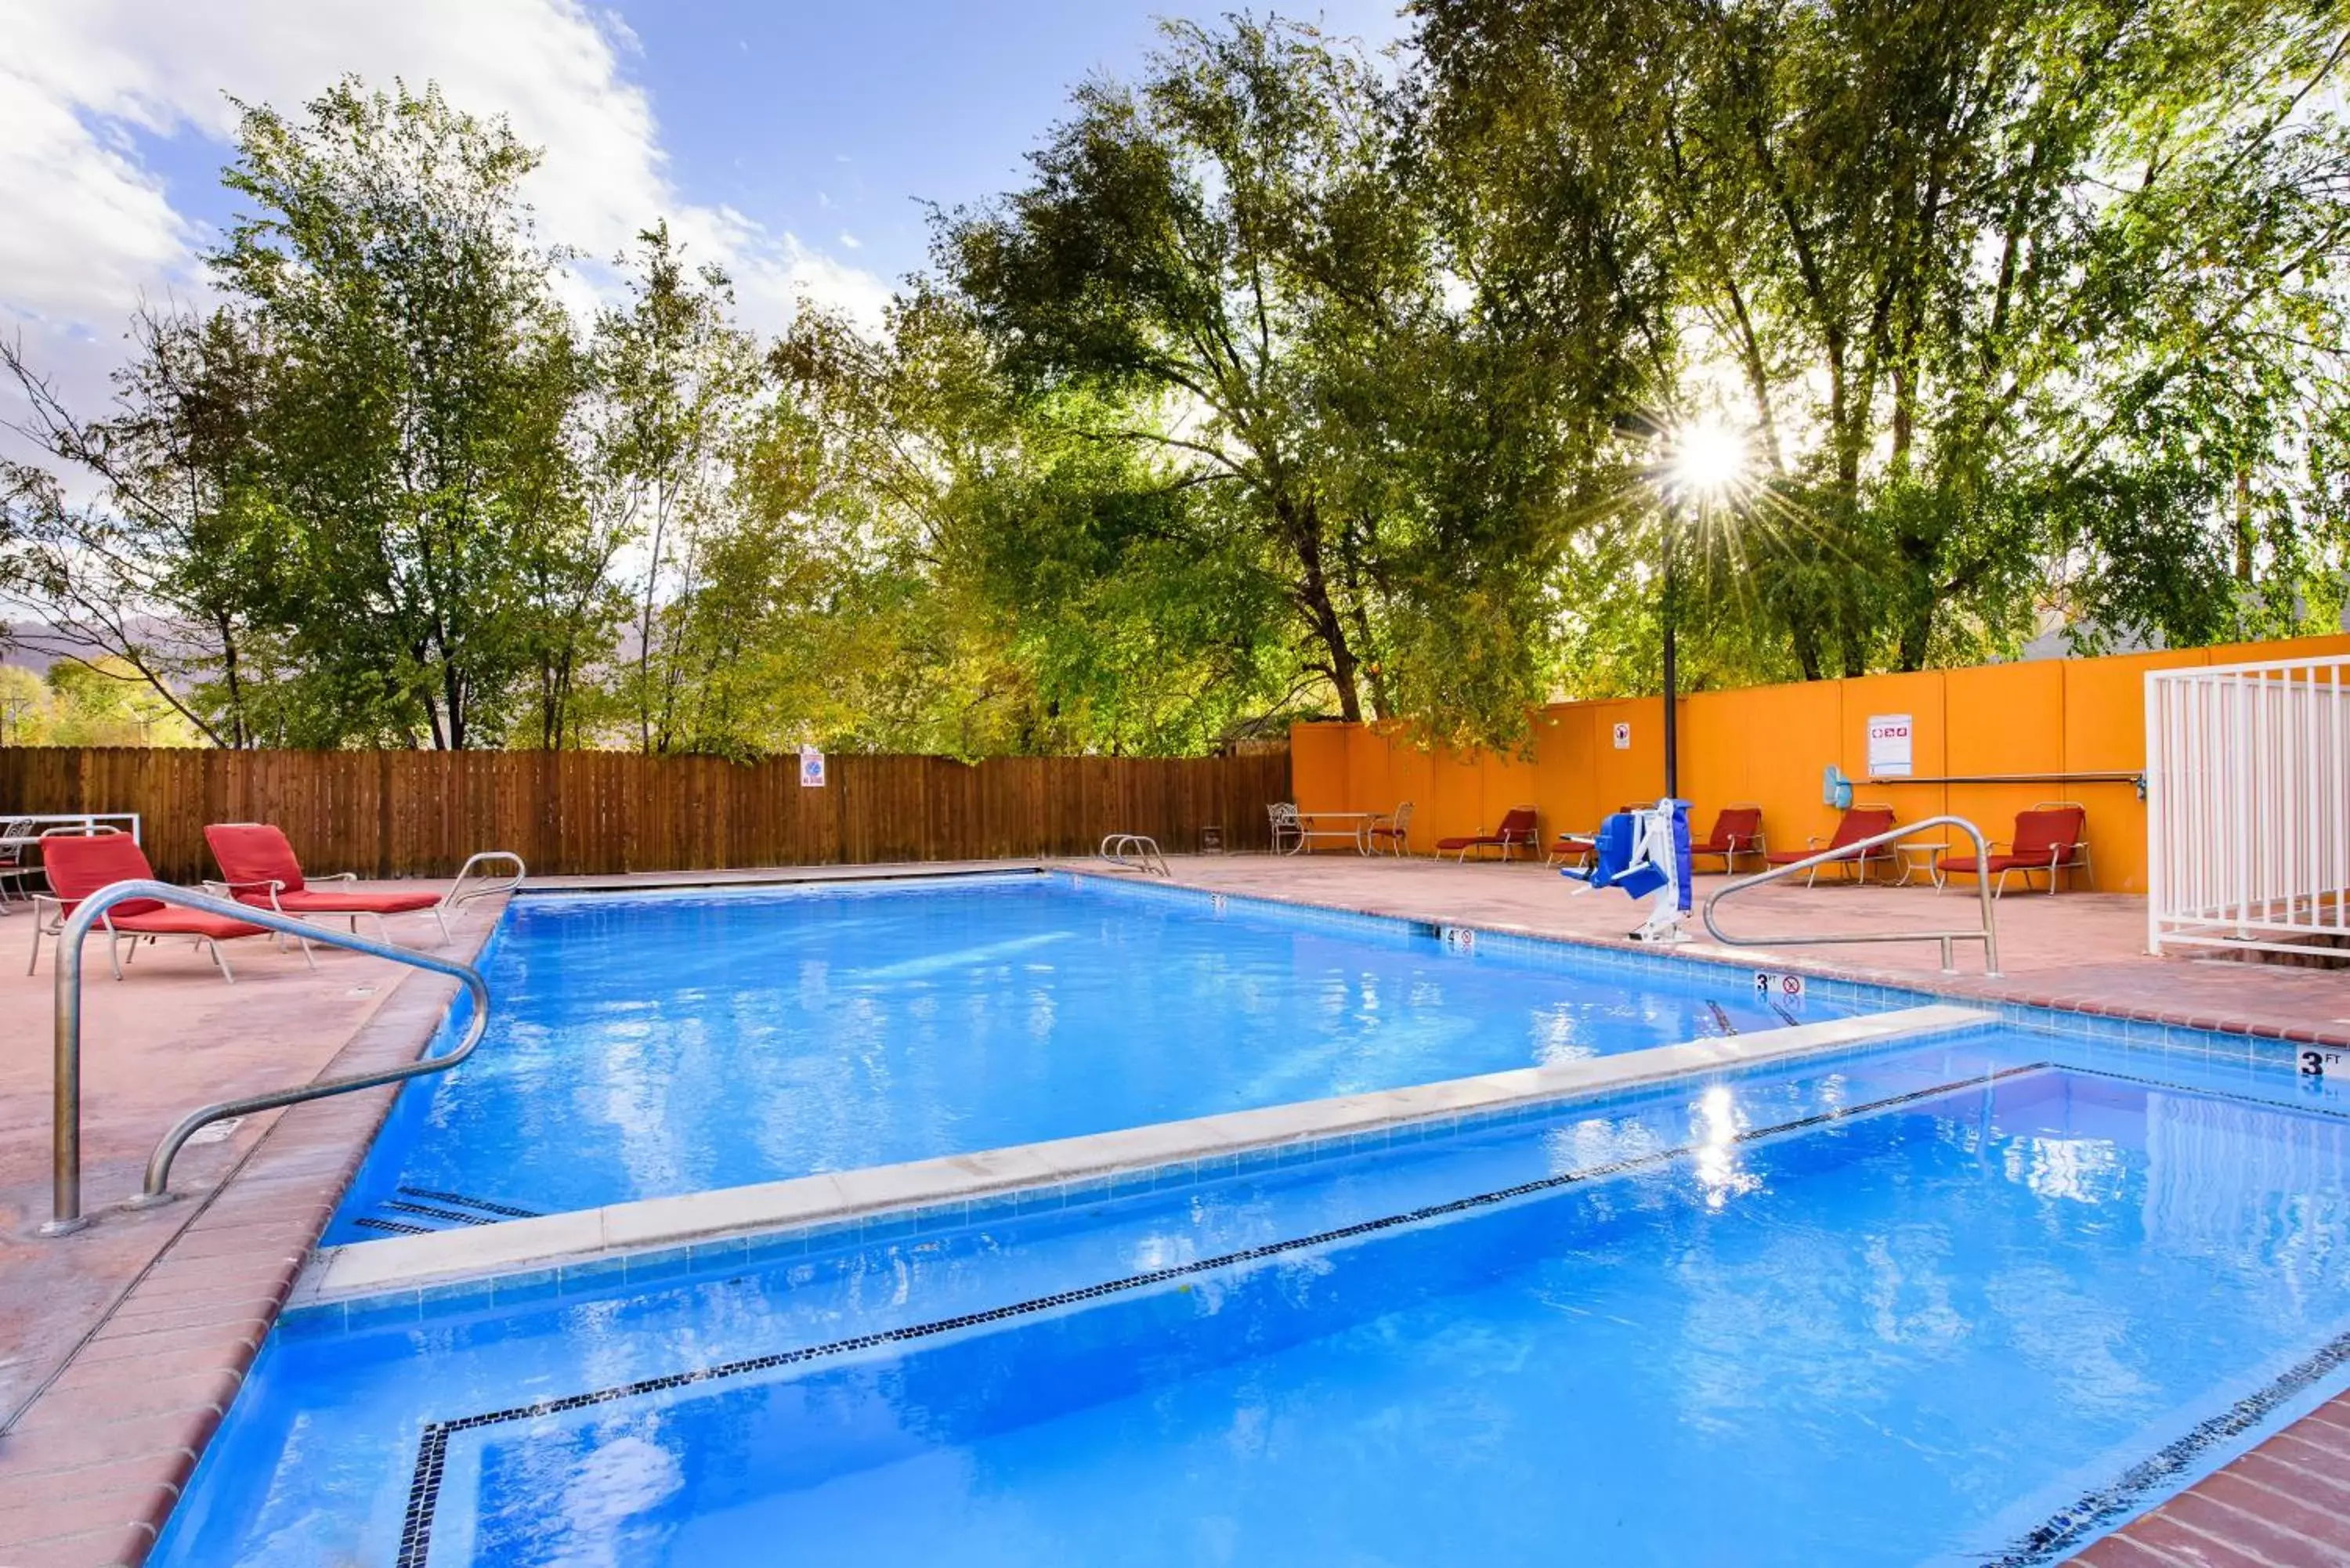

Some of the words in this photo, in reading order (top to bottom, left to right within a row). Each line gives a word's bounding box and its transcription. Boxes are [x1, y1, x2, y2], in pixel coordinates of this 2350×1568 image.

[1757, 974, 1768, 990] 3
[2301, 1051, 2323, 1075] 3
[2326, 1053, 2341, 1064] FT
